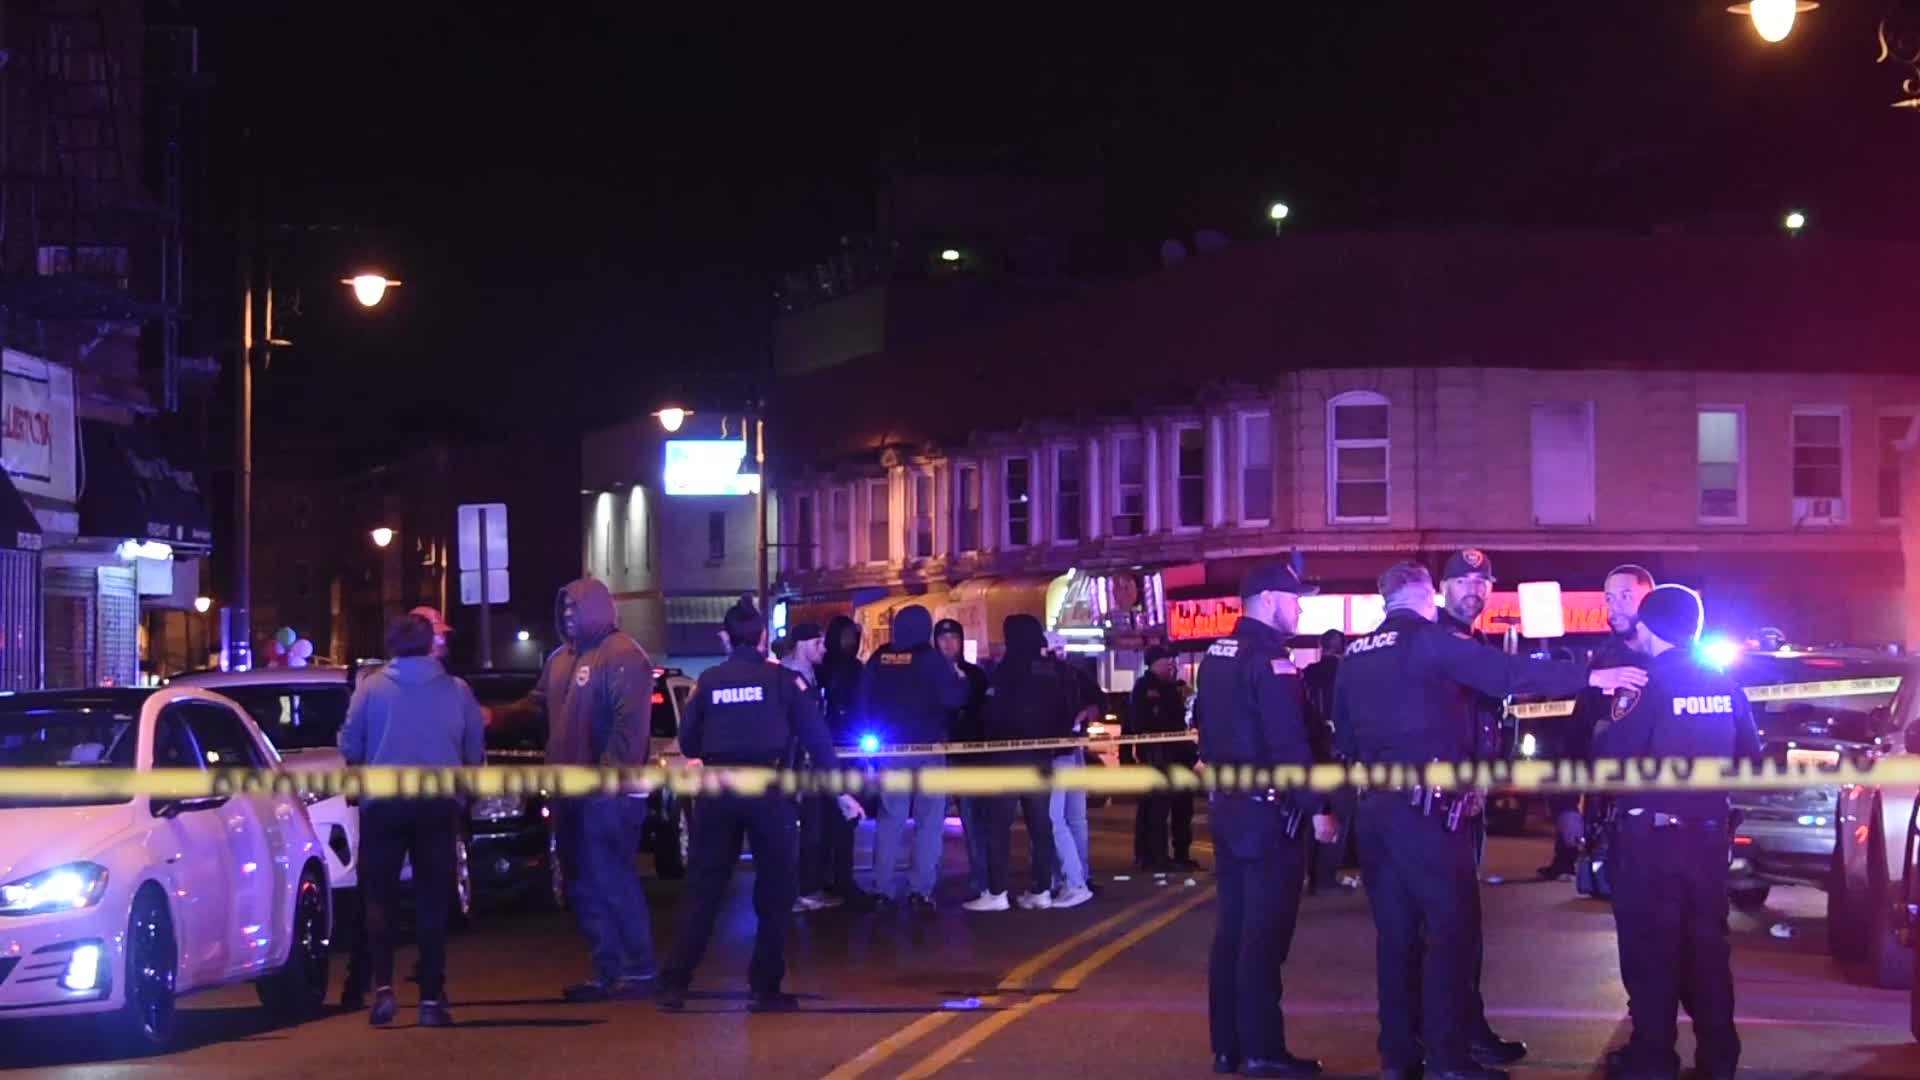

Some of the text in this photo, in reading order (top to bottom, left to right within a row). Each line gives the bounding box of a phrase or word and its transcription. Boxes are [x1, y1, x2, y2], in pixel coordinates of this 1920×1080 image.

[1345, 631, 1398, 656] POLICE
[712, 686, 764, 704] POLICE
[1673, 695, 1733, 715] POLICE
